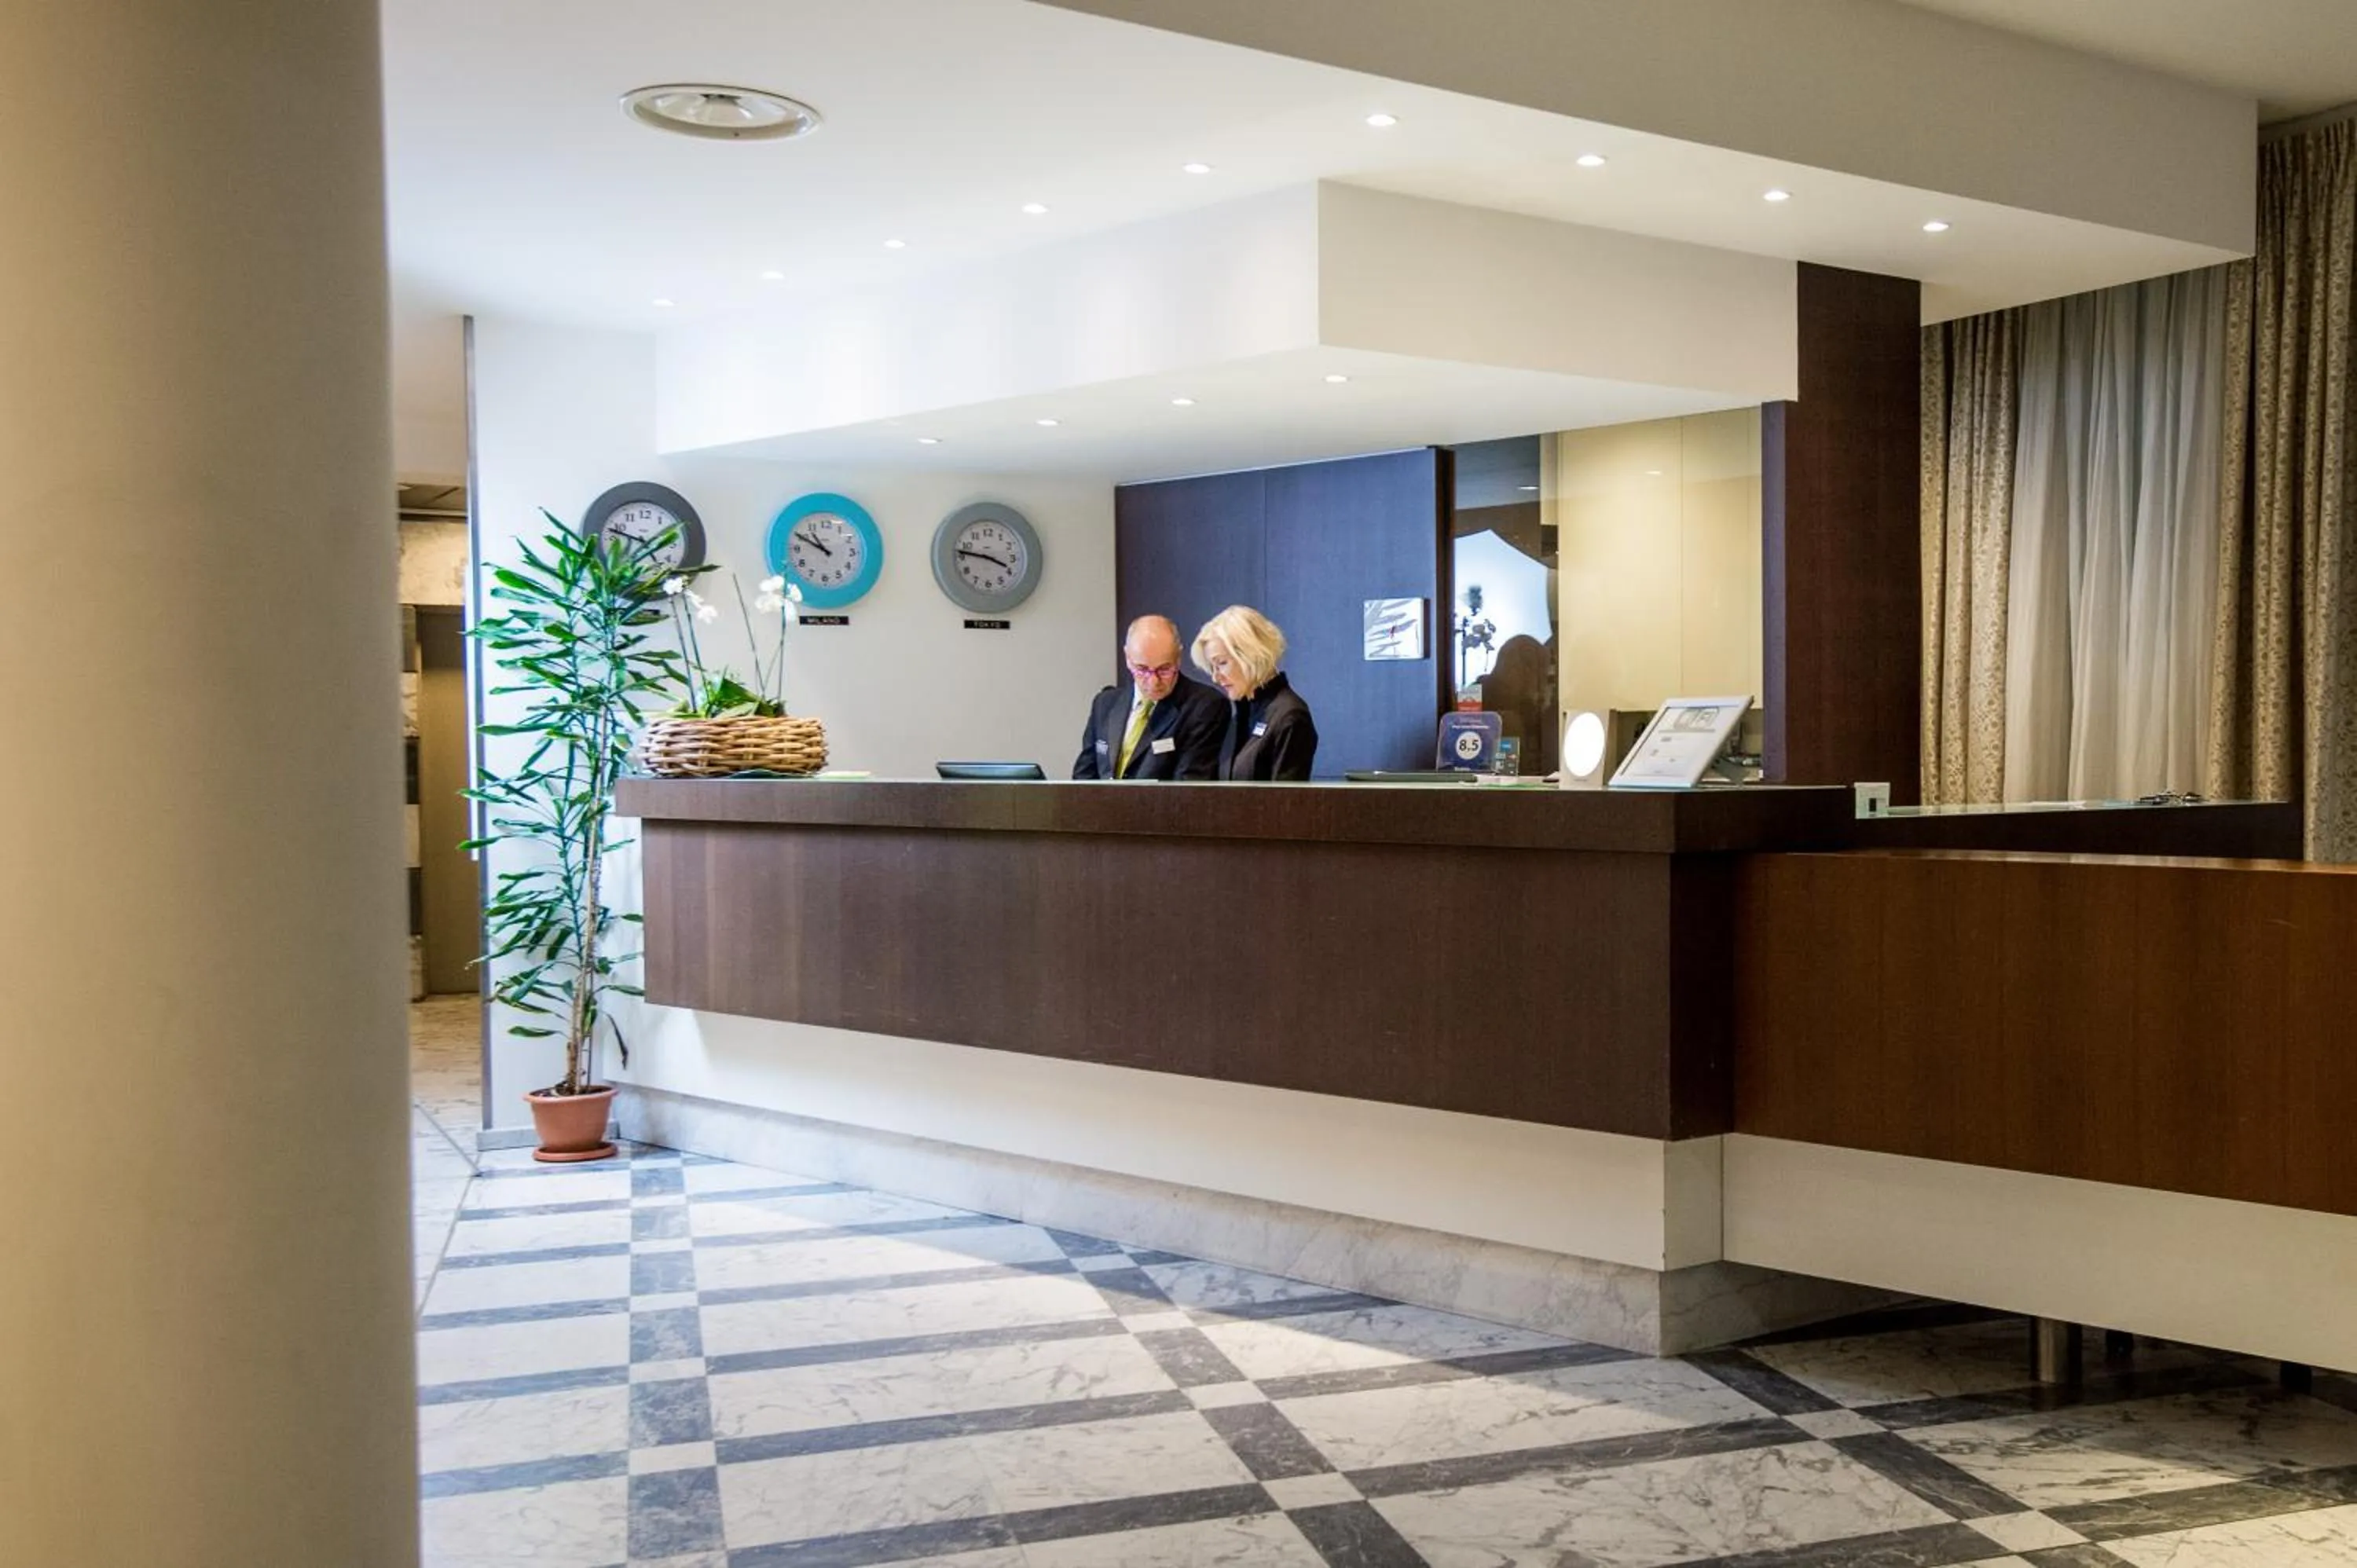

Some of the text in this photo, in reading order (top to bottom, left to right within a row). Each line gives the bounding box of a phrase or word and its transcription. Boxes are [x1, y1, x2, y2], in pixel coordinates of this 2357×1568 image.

[625, 513, 635, 522] 11
[639, 510, 651, 519] 12
[658, 516, 662, 525] 1
[821, 520, 832, 529] 12
[614, 522, 626, 532] 10
[808, 522, 817, 532] 11
[837, 526, 841, 535] 1
[972, 532, 980, 540] 11
[983, 528, 994, 537] 12
[962, 541, 973, 550] 10
